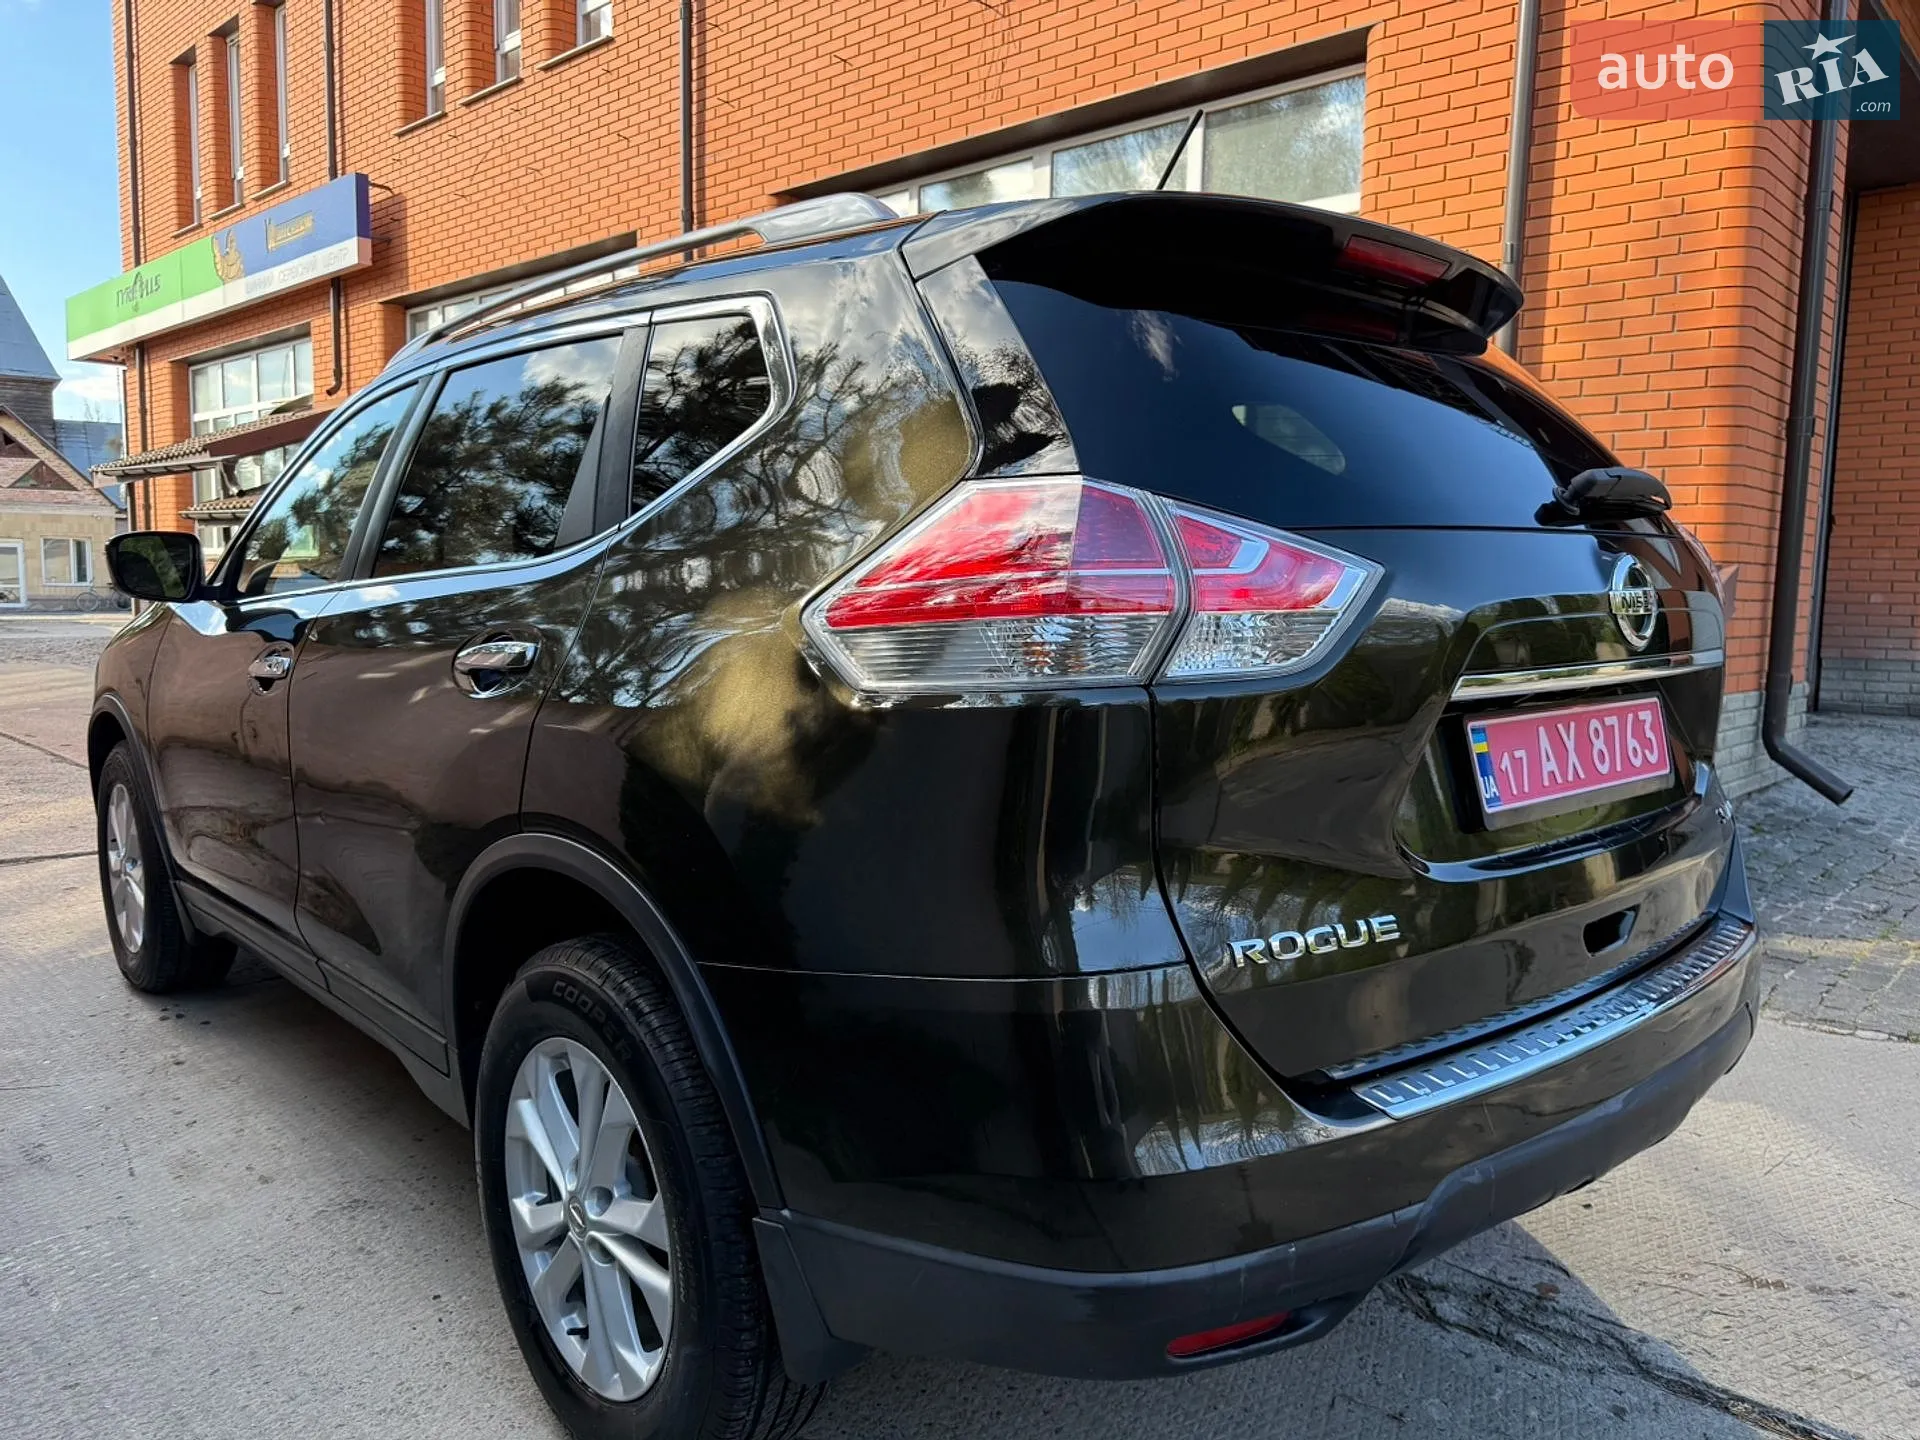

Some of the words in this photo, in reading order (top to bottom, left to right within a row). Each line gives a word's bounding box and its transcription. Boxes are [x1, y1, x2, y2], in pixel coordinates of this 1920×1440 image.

[1483, 776, 1499, 798] UA
[1500, 750, 1529, 796] 17
[1537, 721, 1585, 787] AX
[1589, 710, 1659, 775] 8763
[1227, 914, 1401, 968] ROGUE
[551, 979, 633, 1061] COOPER
